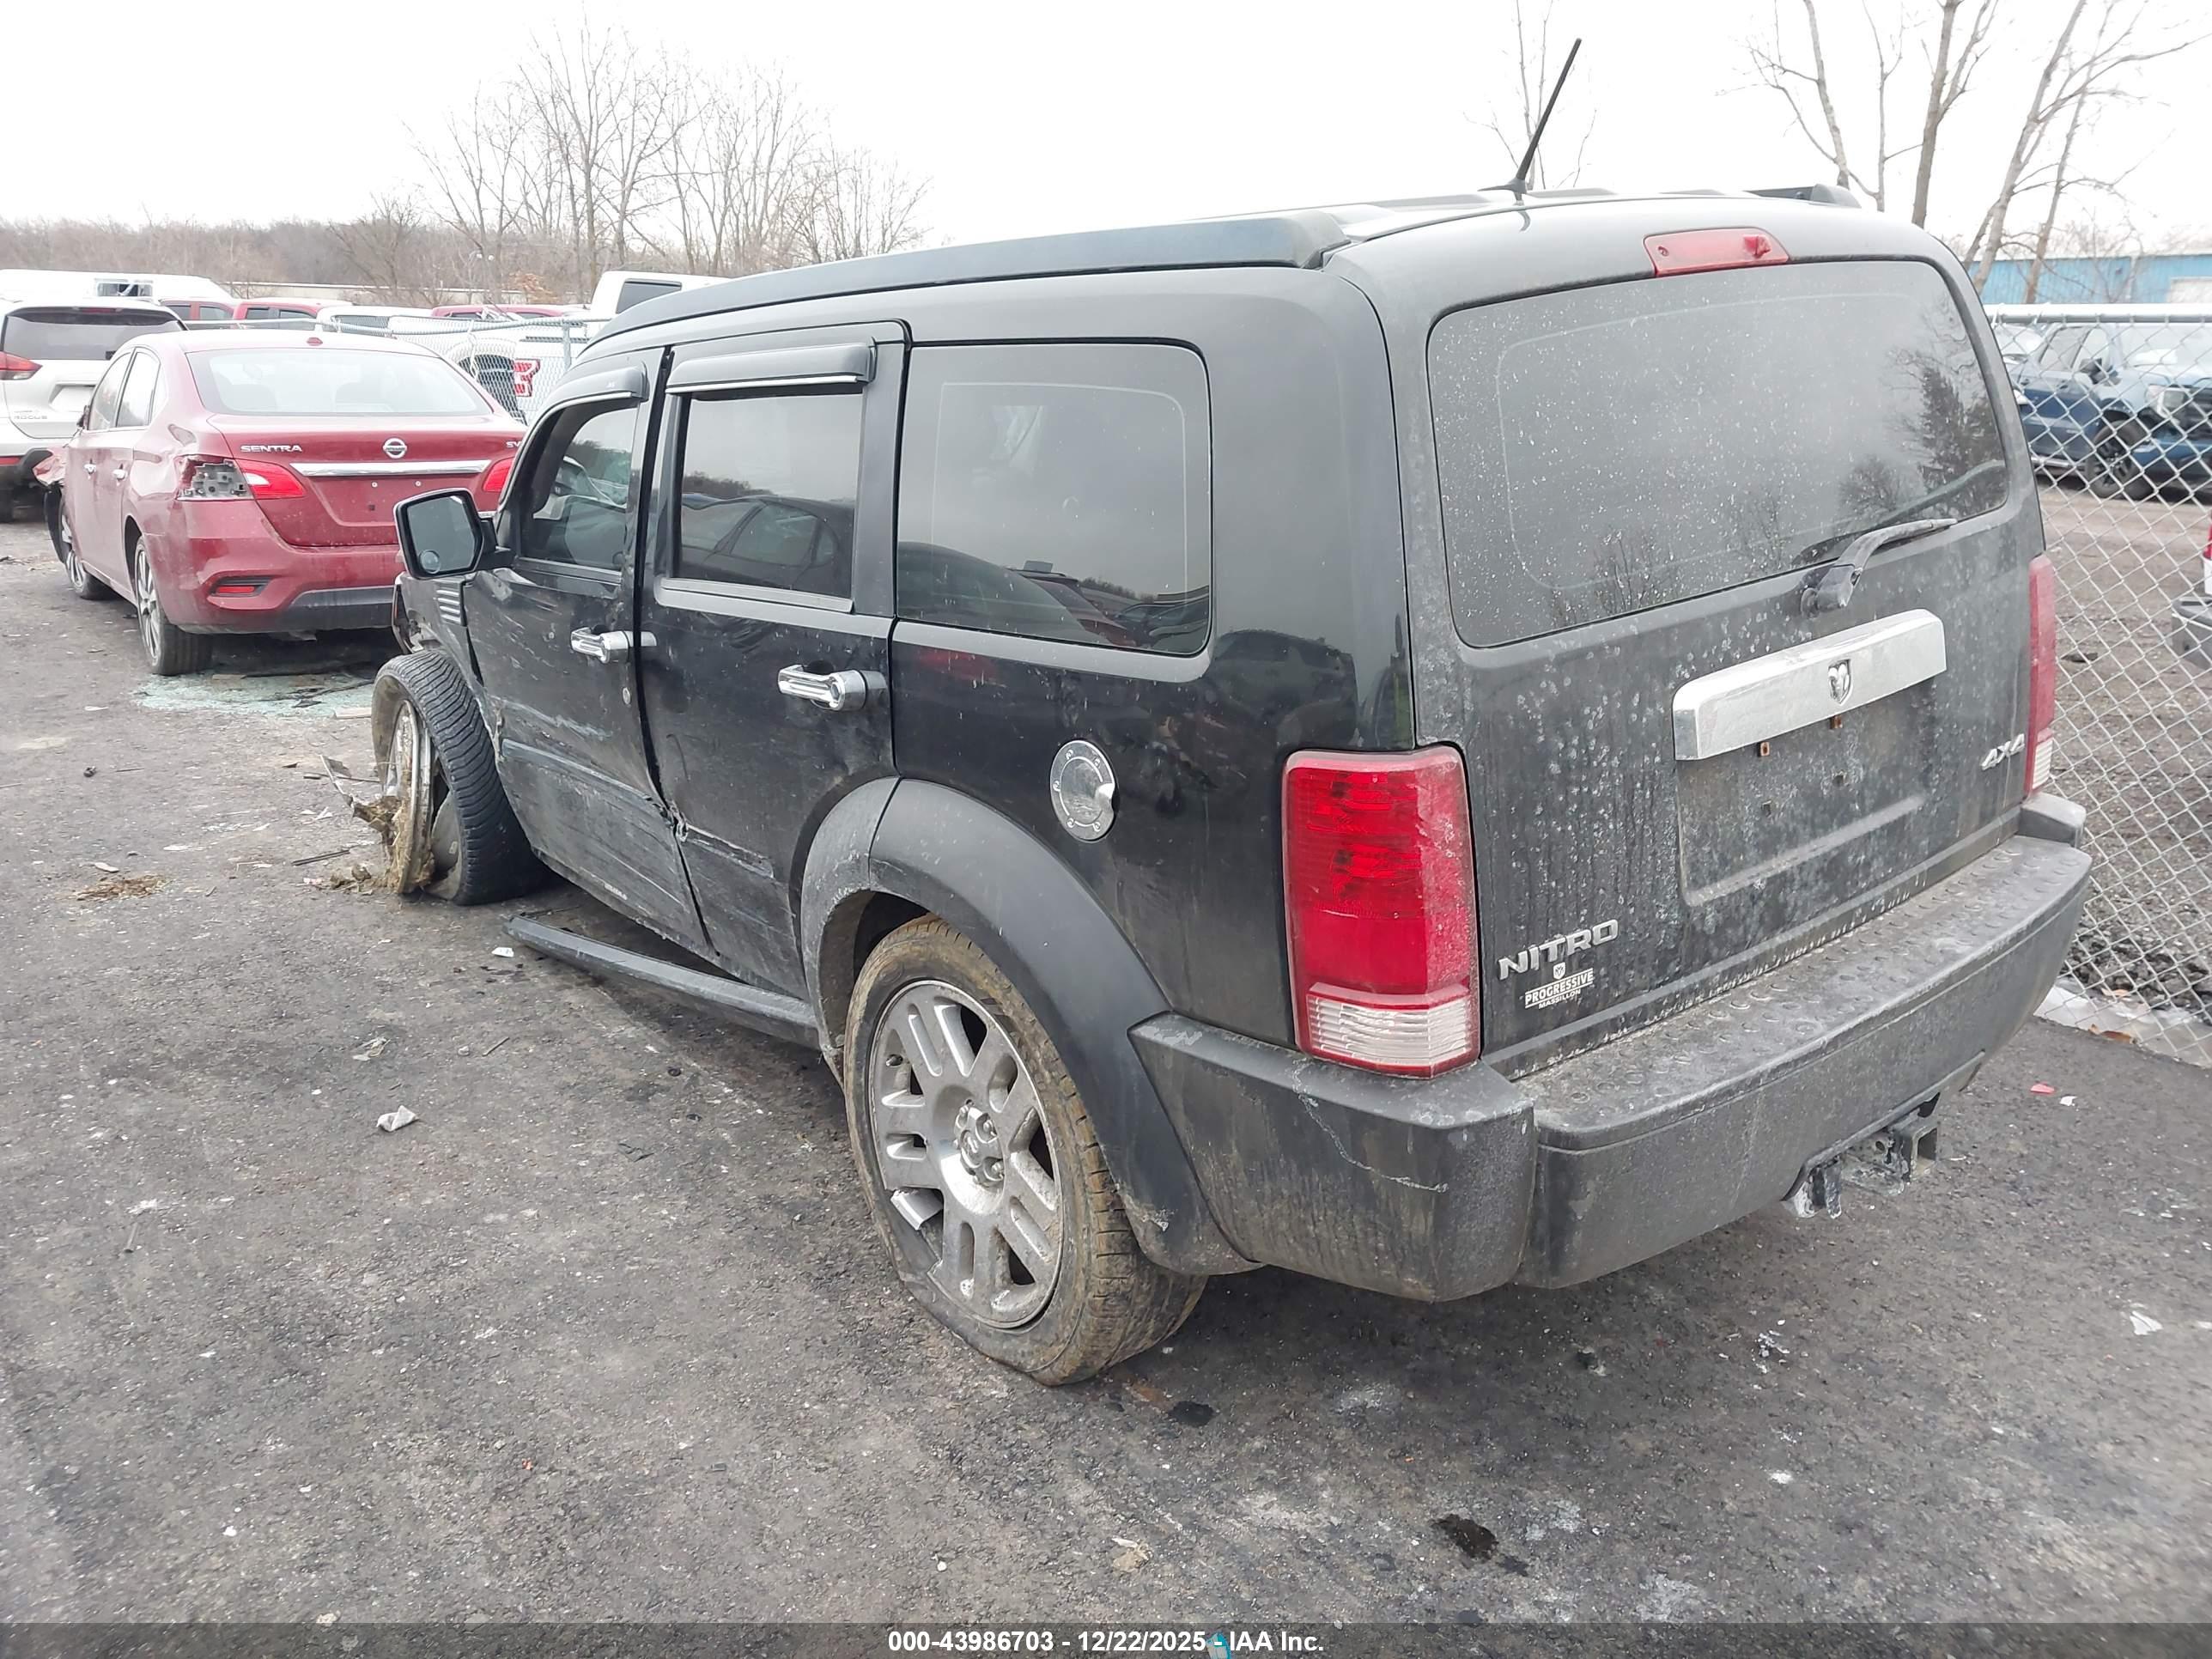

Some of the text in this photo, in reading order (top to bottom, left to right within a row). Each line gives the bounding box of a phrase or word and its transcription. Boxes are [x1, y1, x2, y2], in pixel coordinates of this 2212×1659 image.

[240, 445, 303, 453] SENTRA
[1498, 919, 1619, 981] NITRO
[1525, 971, 1595, 1006] PROGRESSIVE
[1538, 988, 1581, 1010] MASSILLON
